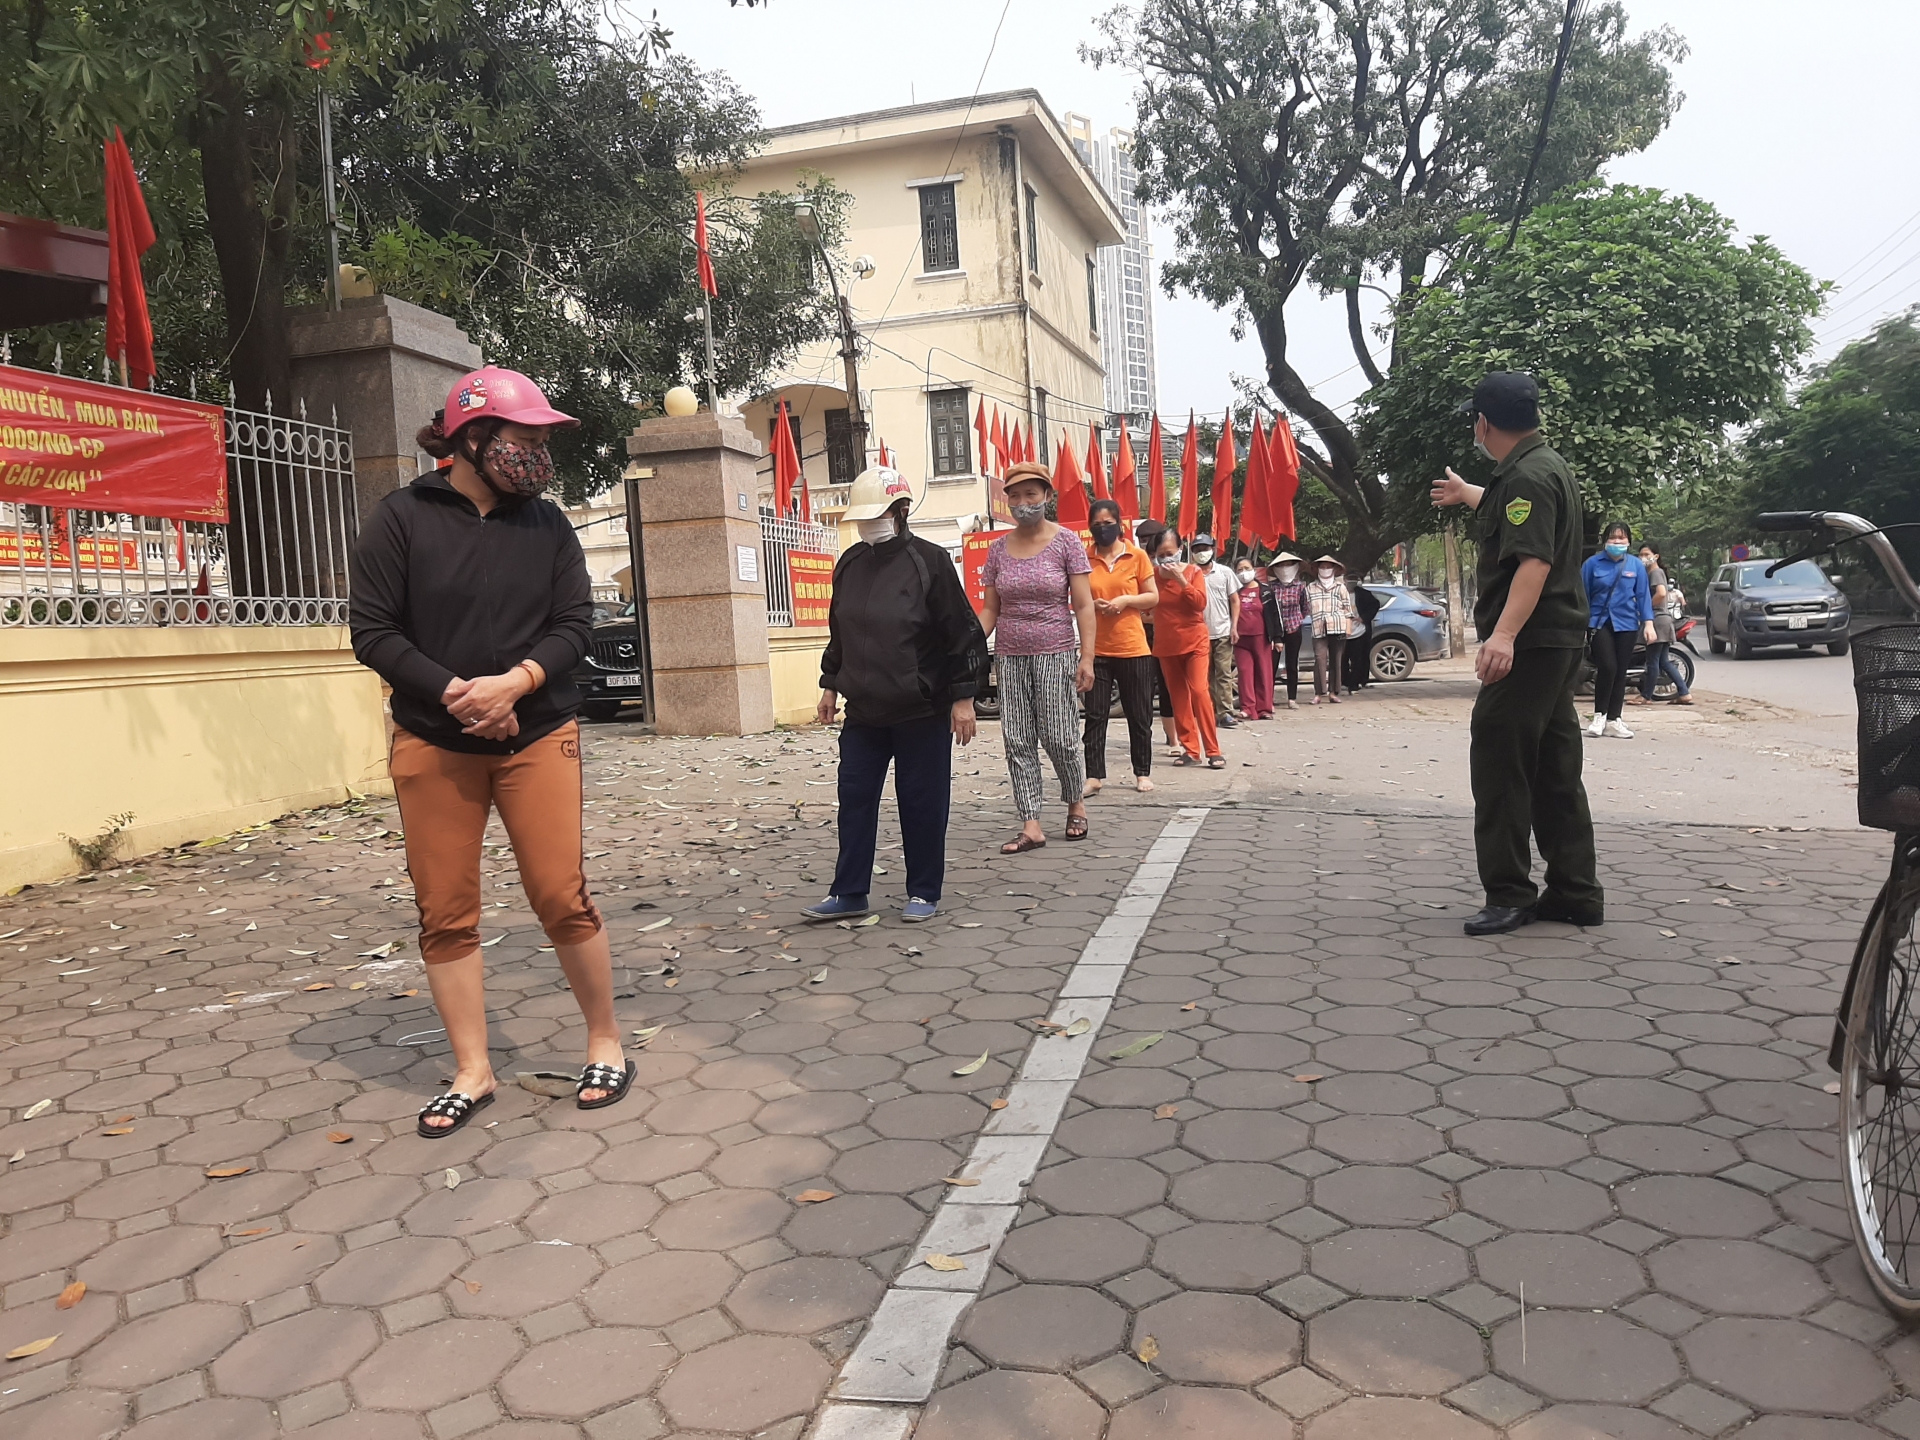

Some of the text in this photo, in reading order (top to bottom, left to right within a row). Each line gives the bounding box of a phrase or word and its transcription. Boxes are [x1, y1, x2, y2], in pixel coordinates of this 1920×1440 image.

[75, 401, 118, 428] MUA
[121, 407, 165, 437] BÁN,
[0, 424, 105, 459] 009/NĐ-CP
[5, 461, 45, 488] CÁC
